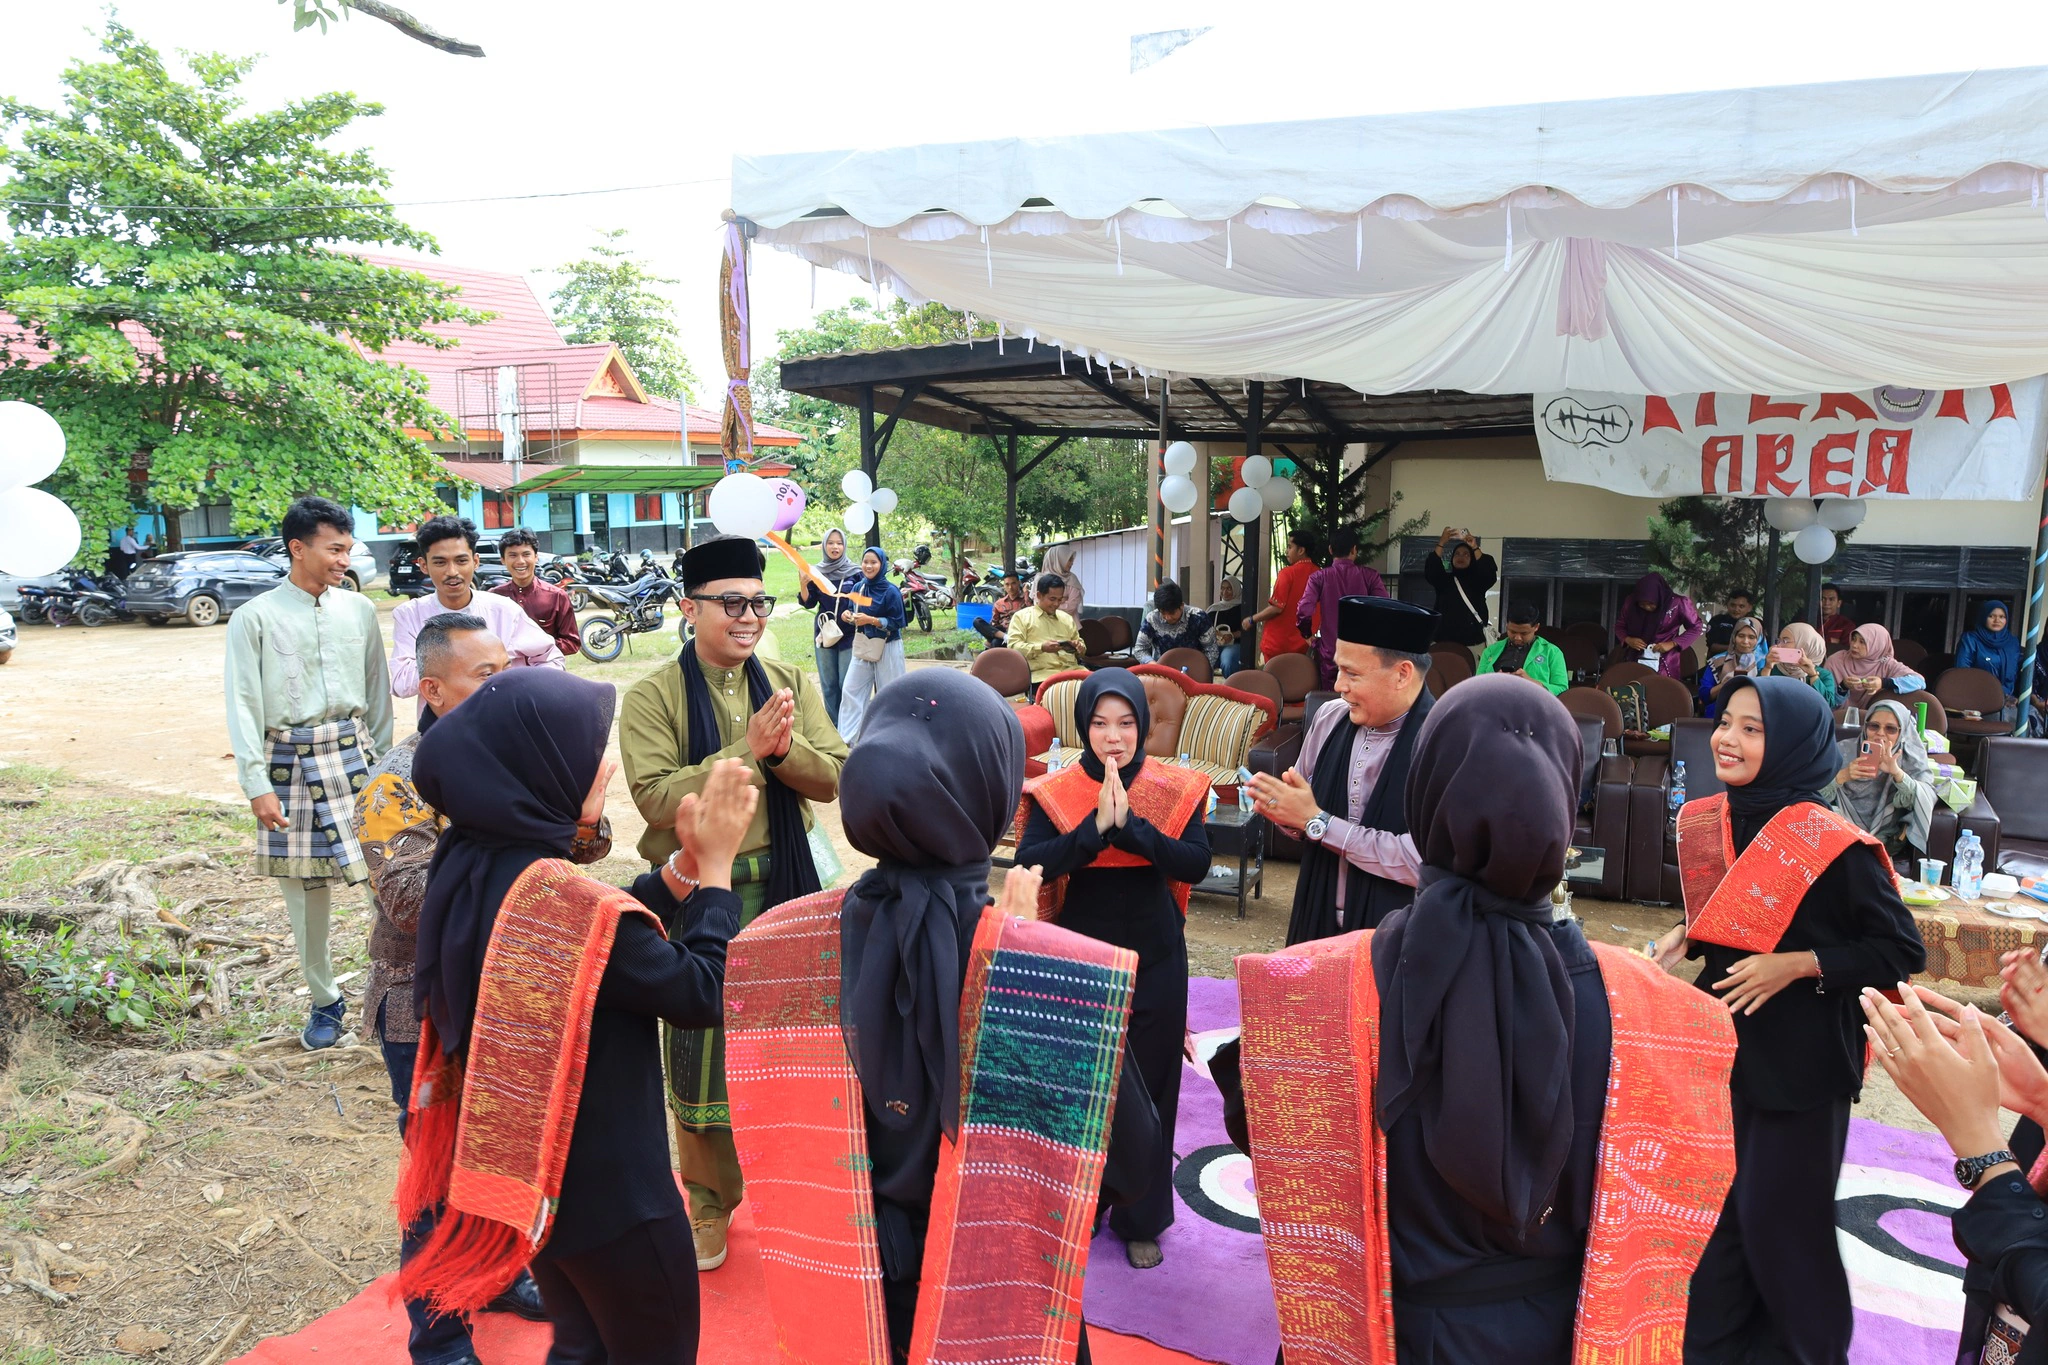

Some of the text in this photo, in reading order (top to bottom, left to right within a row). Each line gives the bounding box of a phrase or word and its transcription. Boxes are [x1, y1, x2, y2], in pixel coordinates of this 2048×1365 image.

[1702, 428, 1914, 498] AREA
[776, 482, 790, 501] YOU
[791, 488, 798, 497] I
